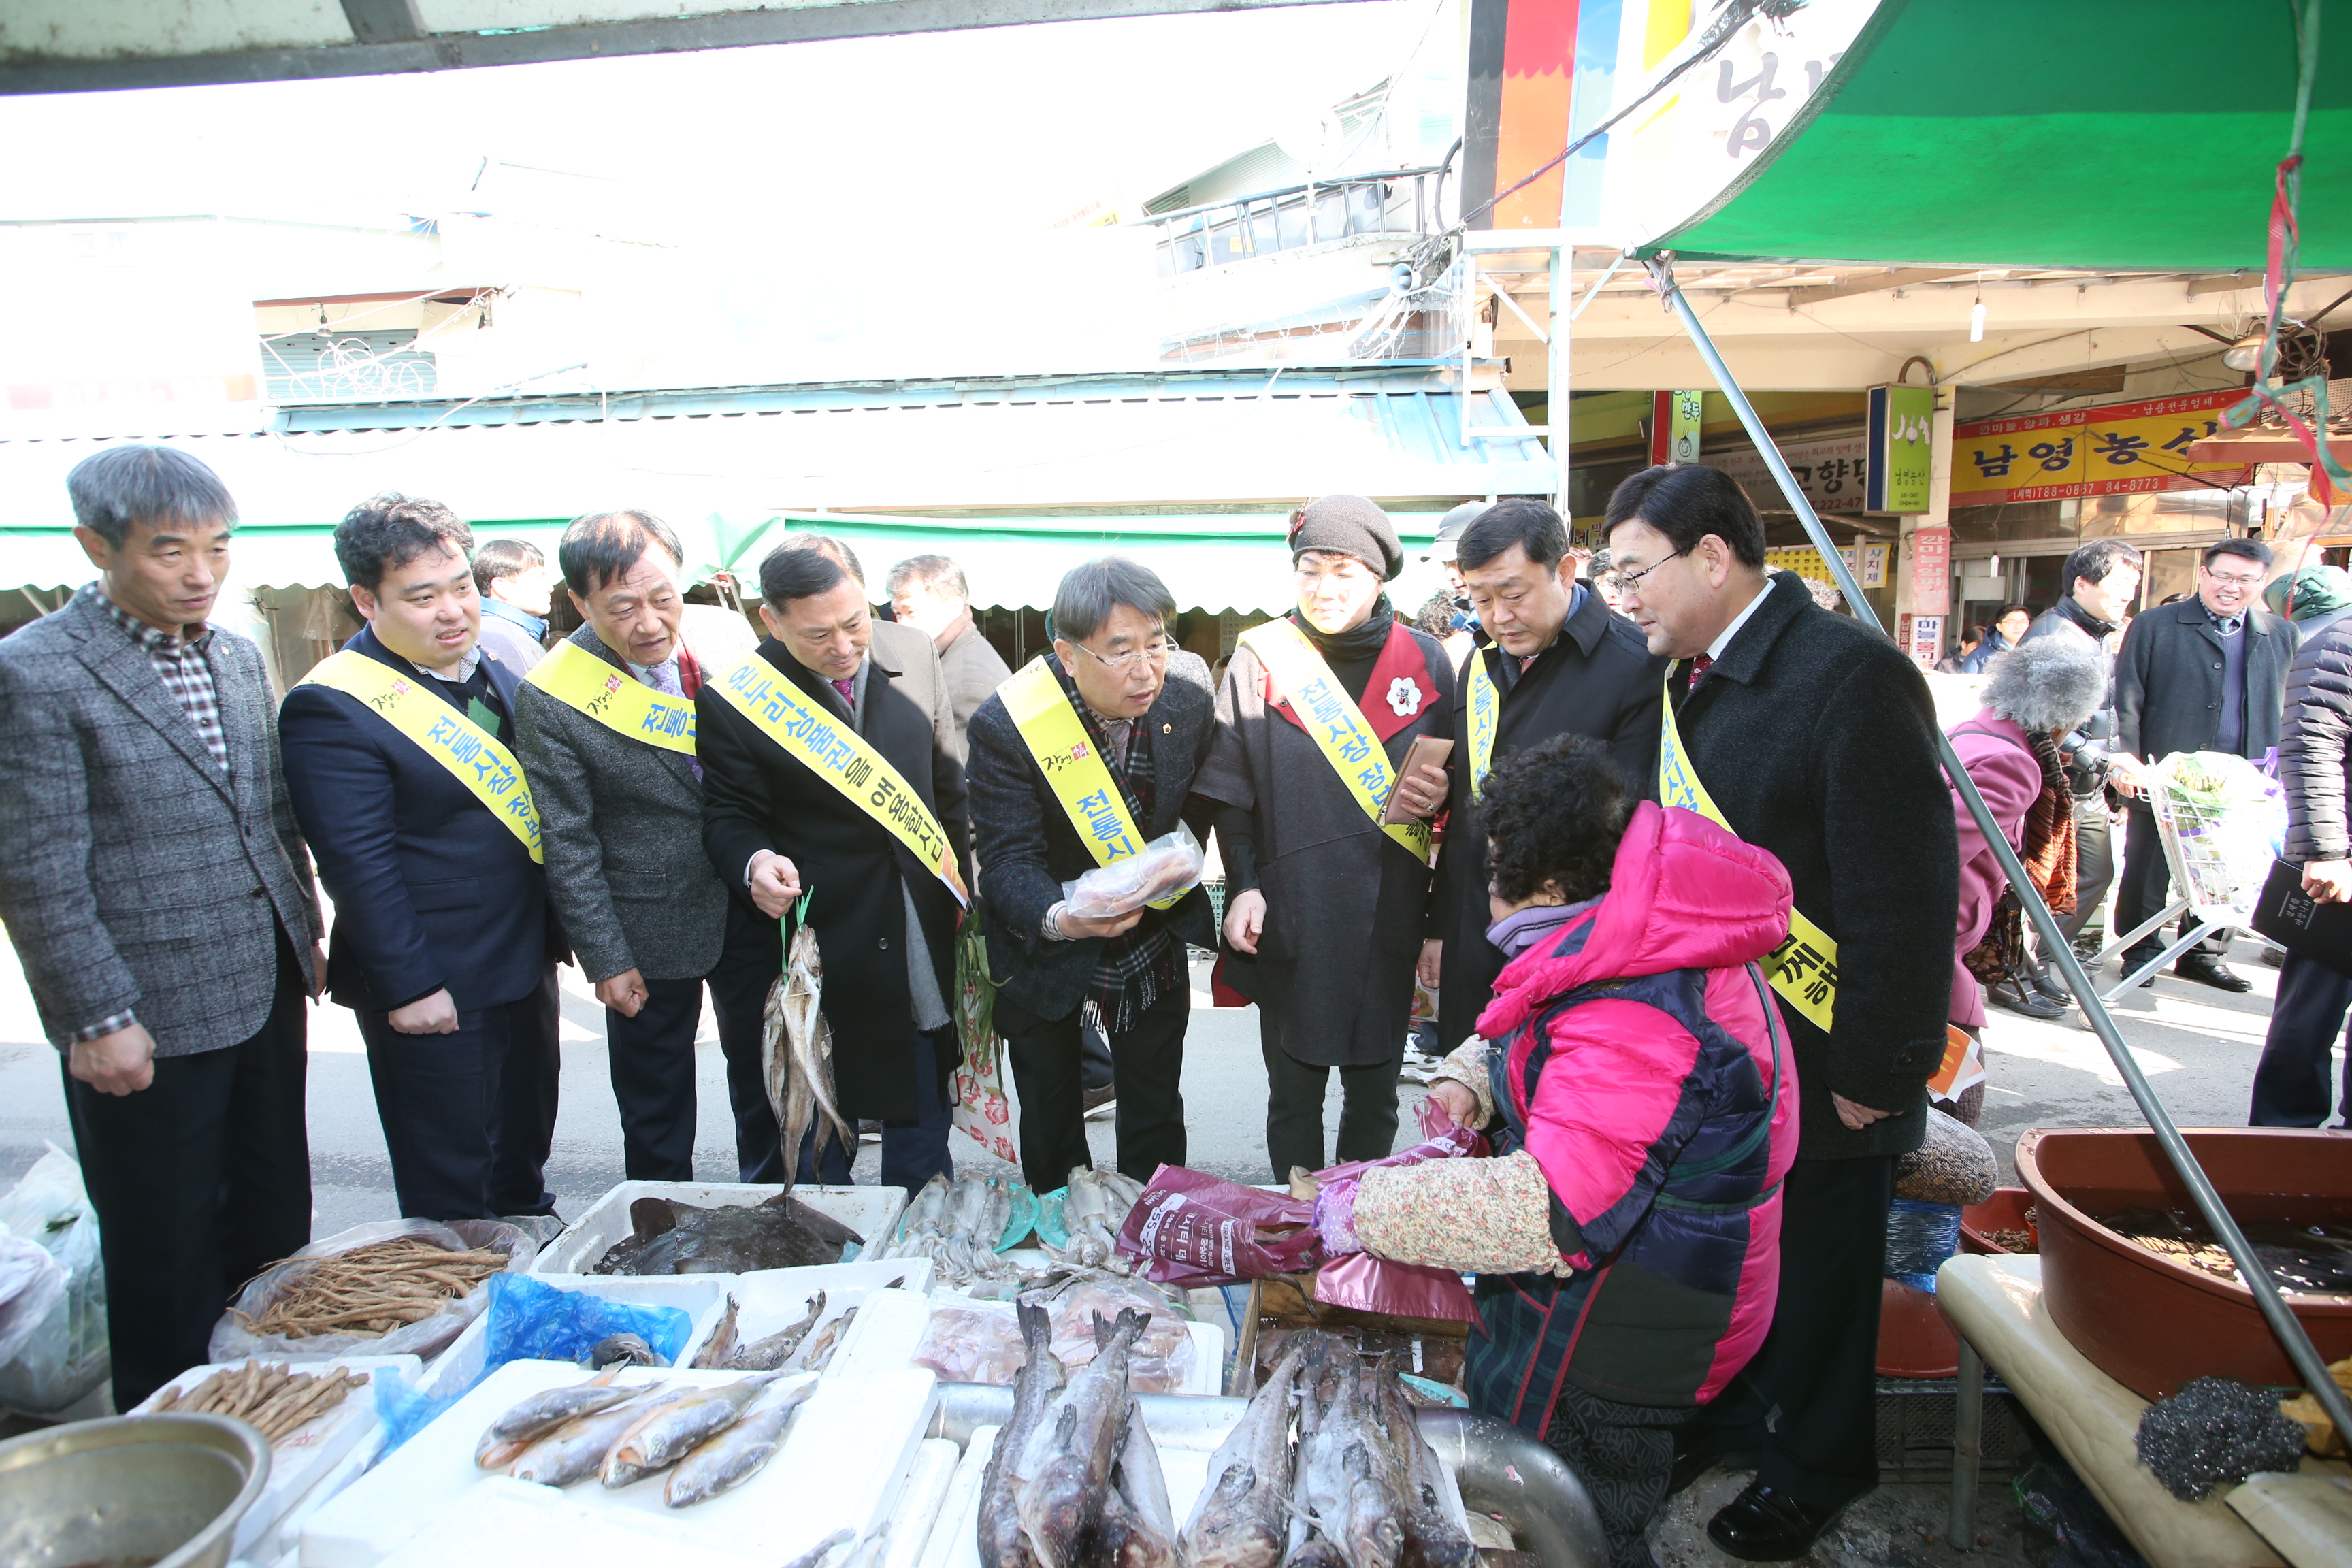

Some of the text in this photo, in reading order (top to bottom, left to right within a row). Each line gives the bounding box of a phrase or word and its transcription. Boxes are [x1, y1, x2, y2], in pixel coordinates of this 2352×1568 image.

[1682, 400, 1700, 422] 만두
[2143, 396, 2214, 416] 납품전문업체
[1812, 445, 1833, 456] 최고의
[1895, 468, 1925, 485] 남영농산
[2106, 478, 2159, 491] 84-8773
[1810, 496, 1865, 510] T.222-47
[1297, 676, 1371, 764] 전통시장
[1473, 672, 1493, 758] 전통시장
[728, 665, 945, 863] 온누리상품권을 애용합시다
[427, 715, 542, 849] 전통시장 장보
[1076, 788, 1137, 860] 전통시
[2294, 899, 2311, 926] 바랍니다
[1200, 1237, 1209, 1262] 중심이
